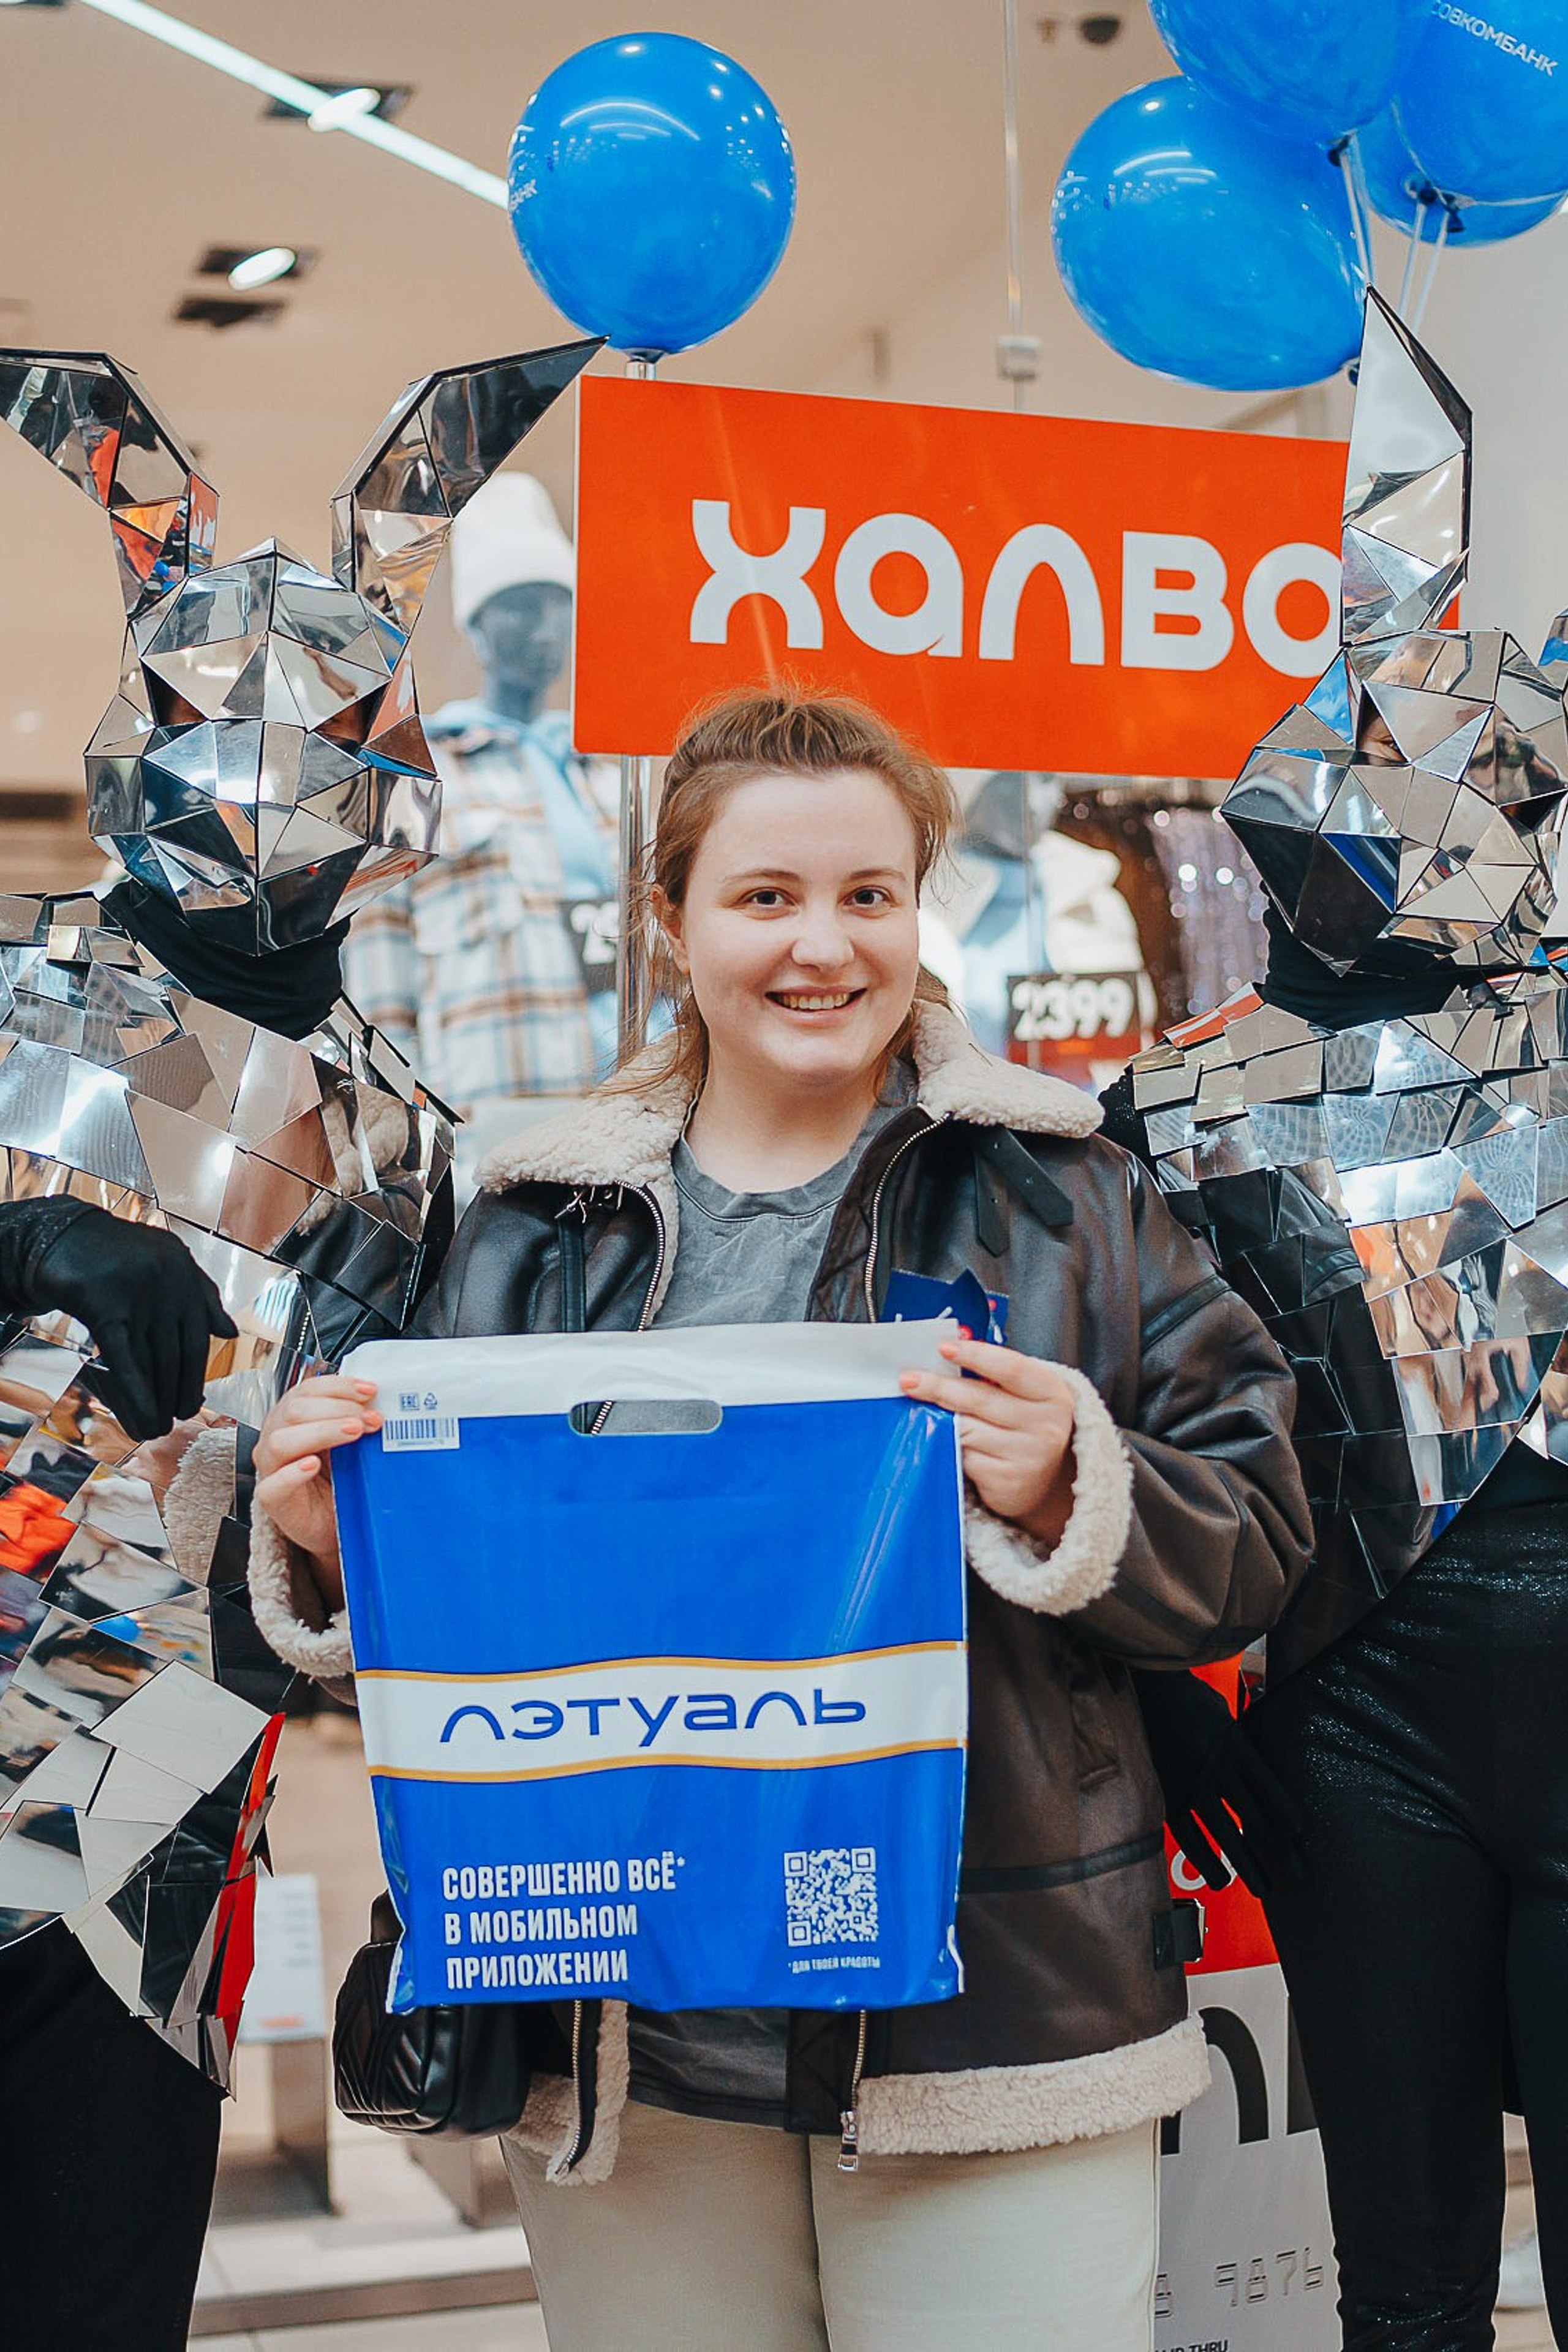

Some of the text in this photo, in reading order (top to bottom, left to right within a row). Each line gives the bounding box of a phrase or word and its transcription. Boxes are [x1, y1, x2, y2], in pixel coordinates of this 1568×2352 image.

[1012, 978, 1133, 1041] 2399
[442, 1860, 620, 1901] СОВЕРШЕННО
[445, 1904, 637, 1945] В МОБИЛЬНОМ
[446, 1949, 628, 1990] ПРИЛОЖЕНИИ
